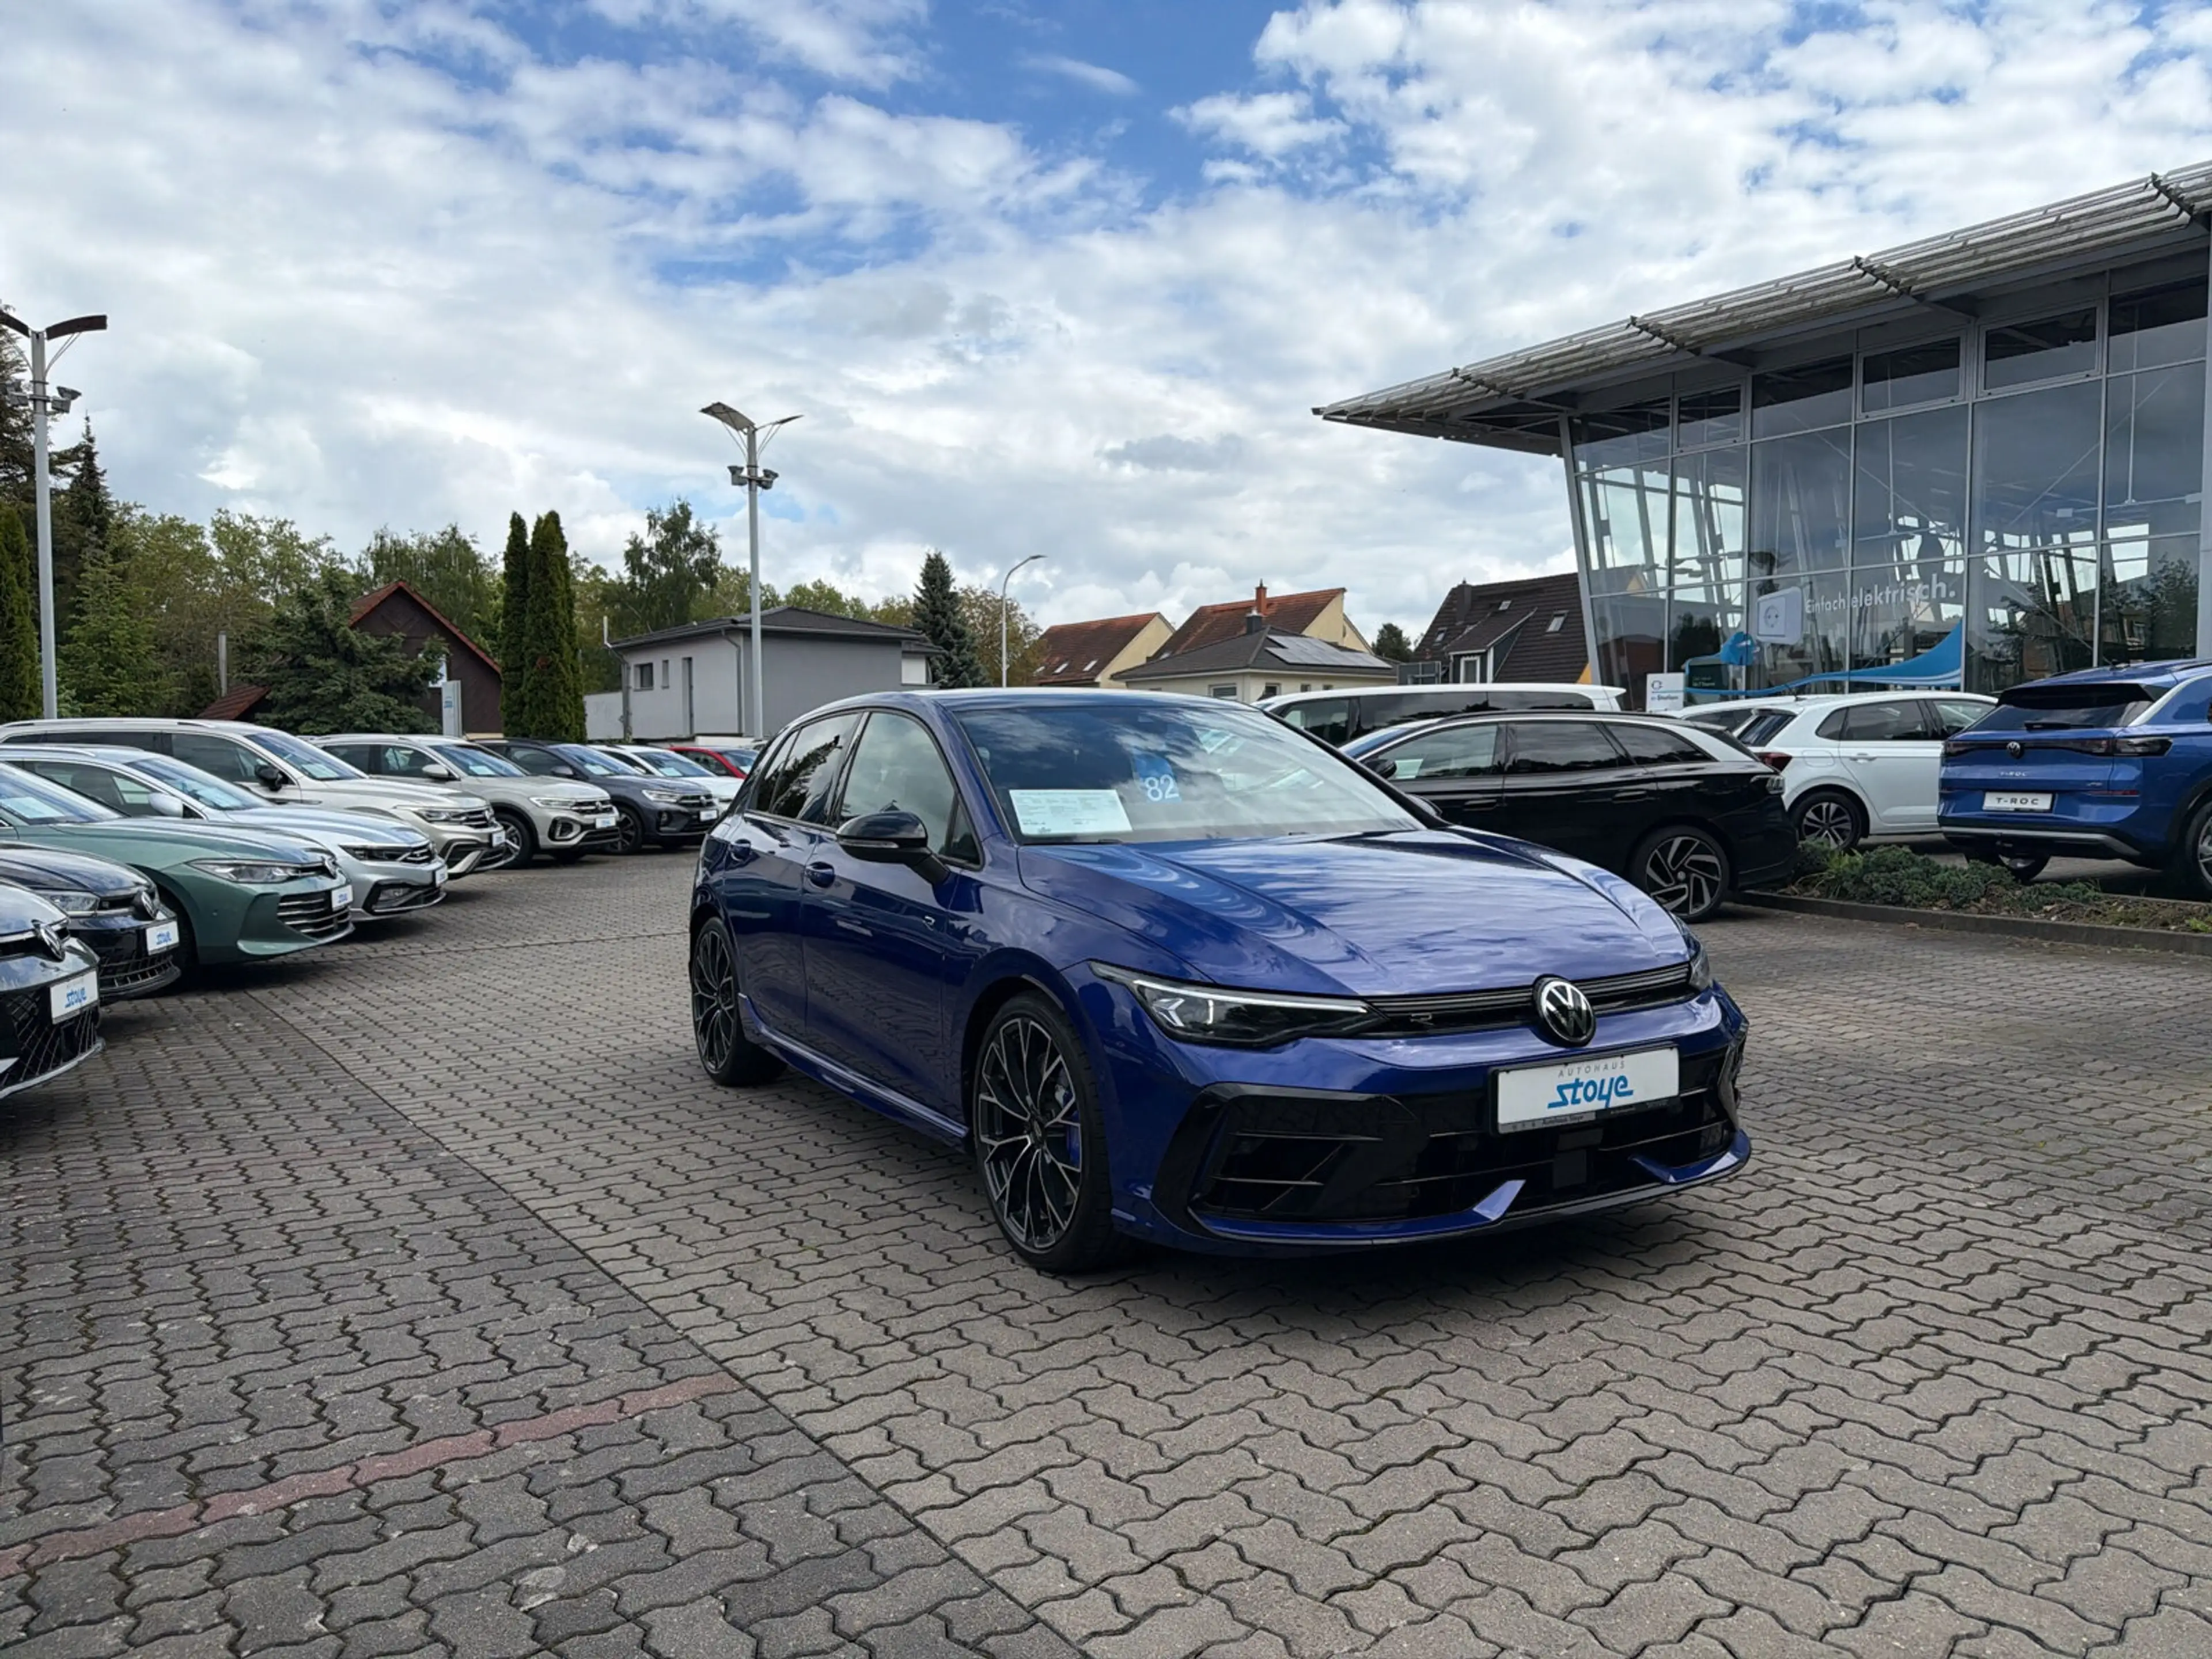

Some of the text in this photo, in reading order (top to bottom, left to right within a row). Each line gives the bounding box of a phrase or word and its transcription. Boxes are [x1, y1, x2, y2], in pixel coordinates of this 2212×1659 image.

[1851, 573, 1956, 608] elektrisch.
[1144, 774, 1180, 802] 82
[1995, 797, 2039, 806] T-ROC
[1558, 1060, 1626, 1078] AUTOHAUS
